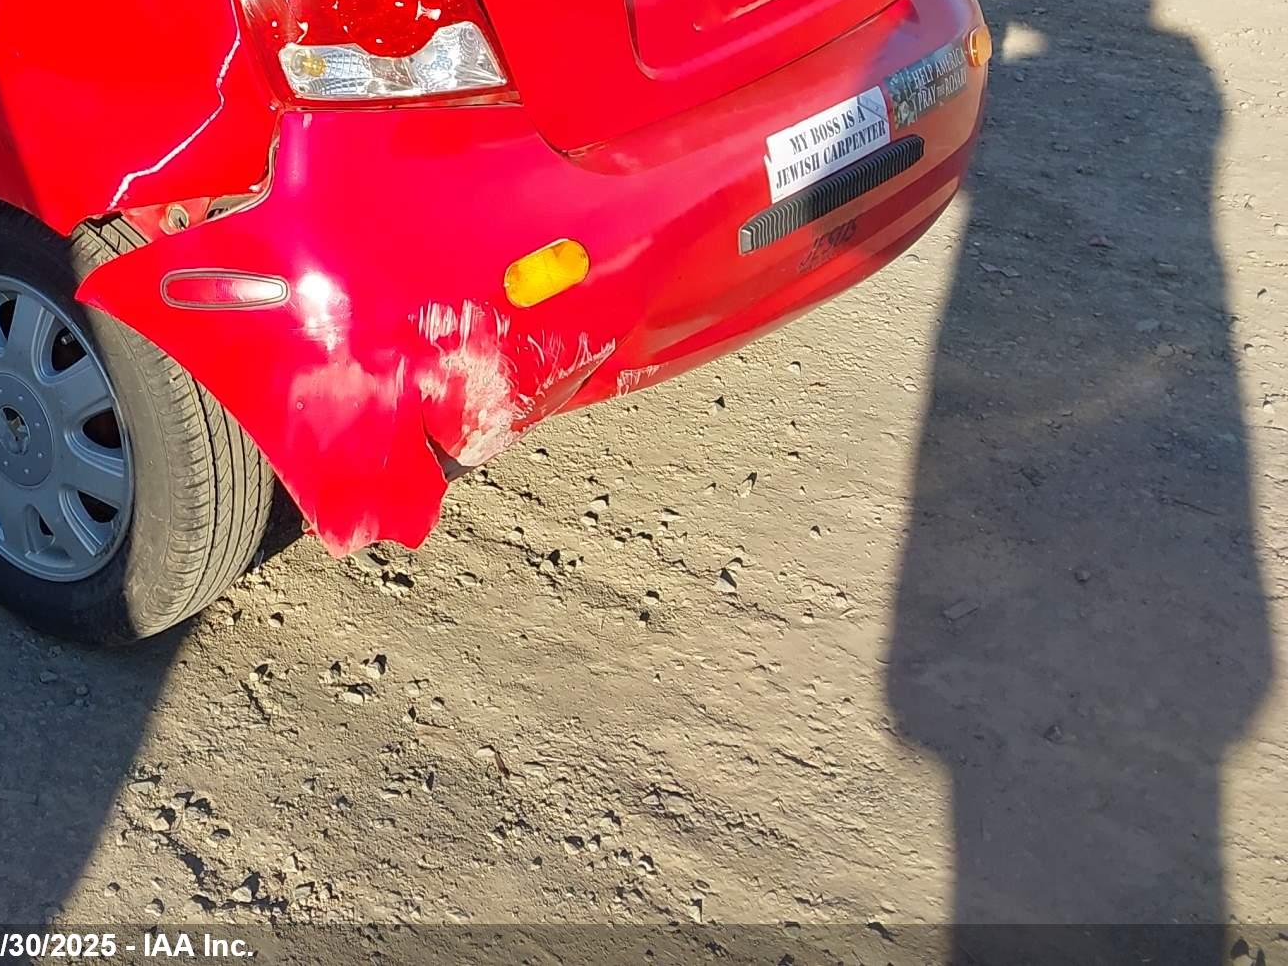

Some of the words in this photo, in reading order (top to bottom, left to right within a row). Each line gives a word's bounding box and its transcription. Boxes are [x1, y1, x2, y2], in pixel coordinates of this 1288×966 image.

[912, 64, 934, 89] HELP
[918, 84, 937, 111] PRAY
[789, 131, 809, 155] MY
[810, 117, 841, 146] BOSS
[841, 109, 855, 130] IS
[856, 105, 866, 124] A
[775, 152, 820, 190] JEWISH
[823, 120, 887, 165] CARPENTER
